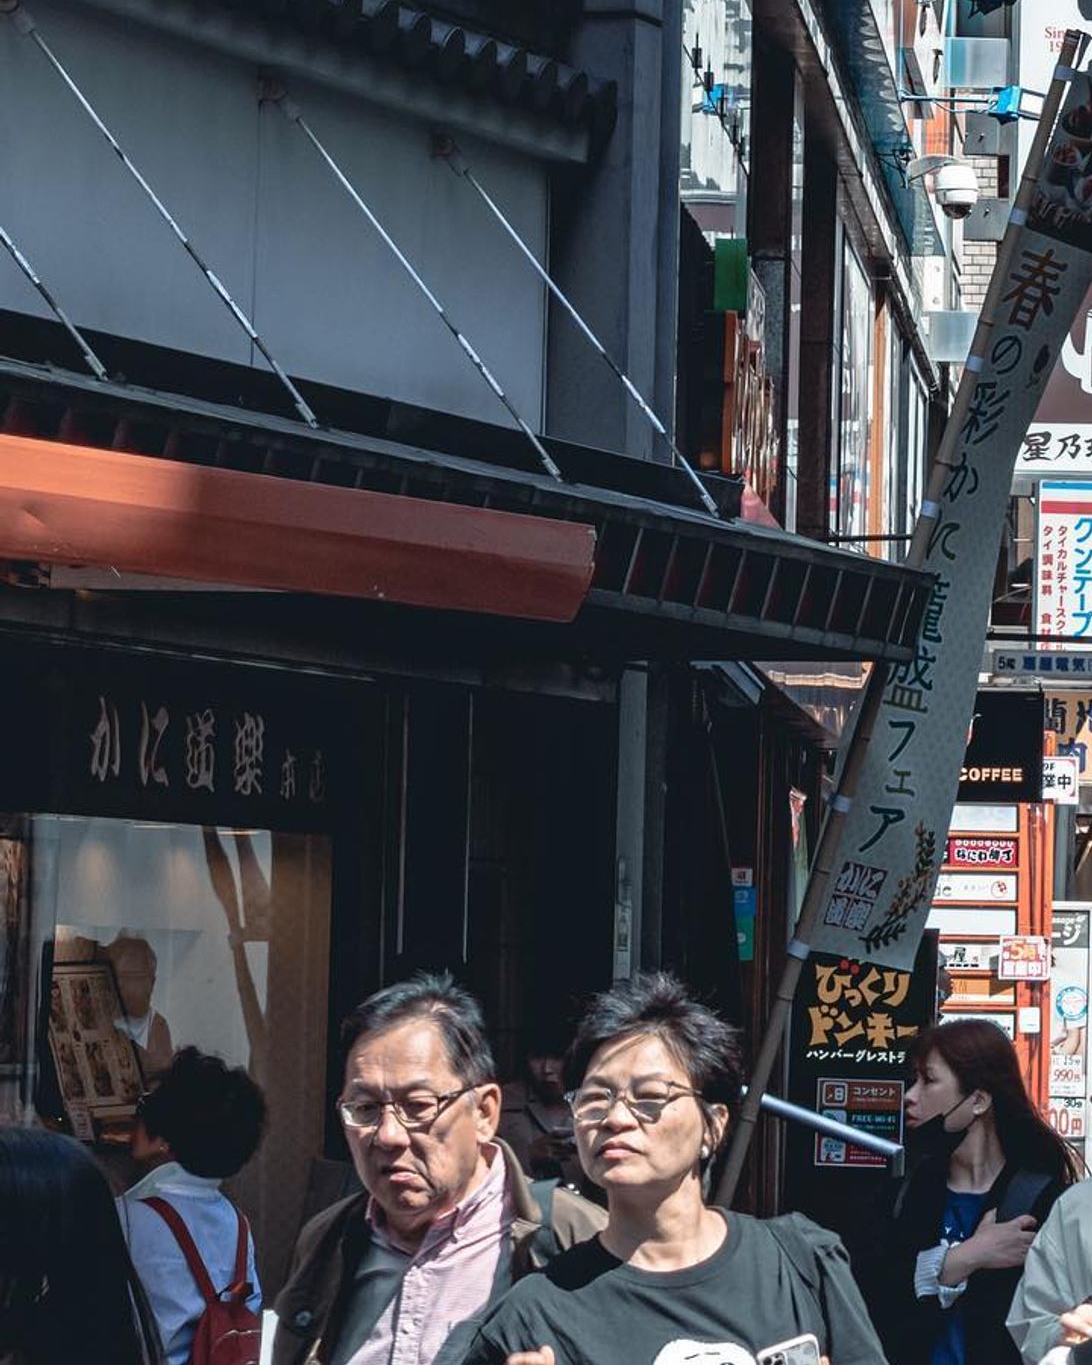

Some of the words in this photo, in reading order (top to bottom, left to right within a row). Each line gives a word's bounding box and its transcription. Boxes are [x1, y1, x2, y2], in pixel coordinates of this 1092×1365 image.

[959, 767, 1023, 782] COFFEE
[816, 960, 911, 1008] びっくり
[808, 1005, 919, 1049] ドンキー
[806, 1049, 906, 1064] ハンバーグレストラ
